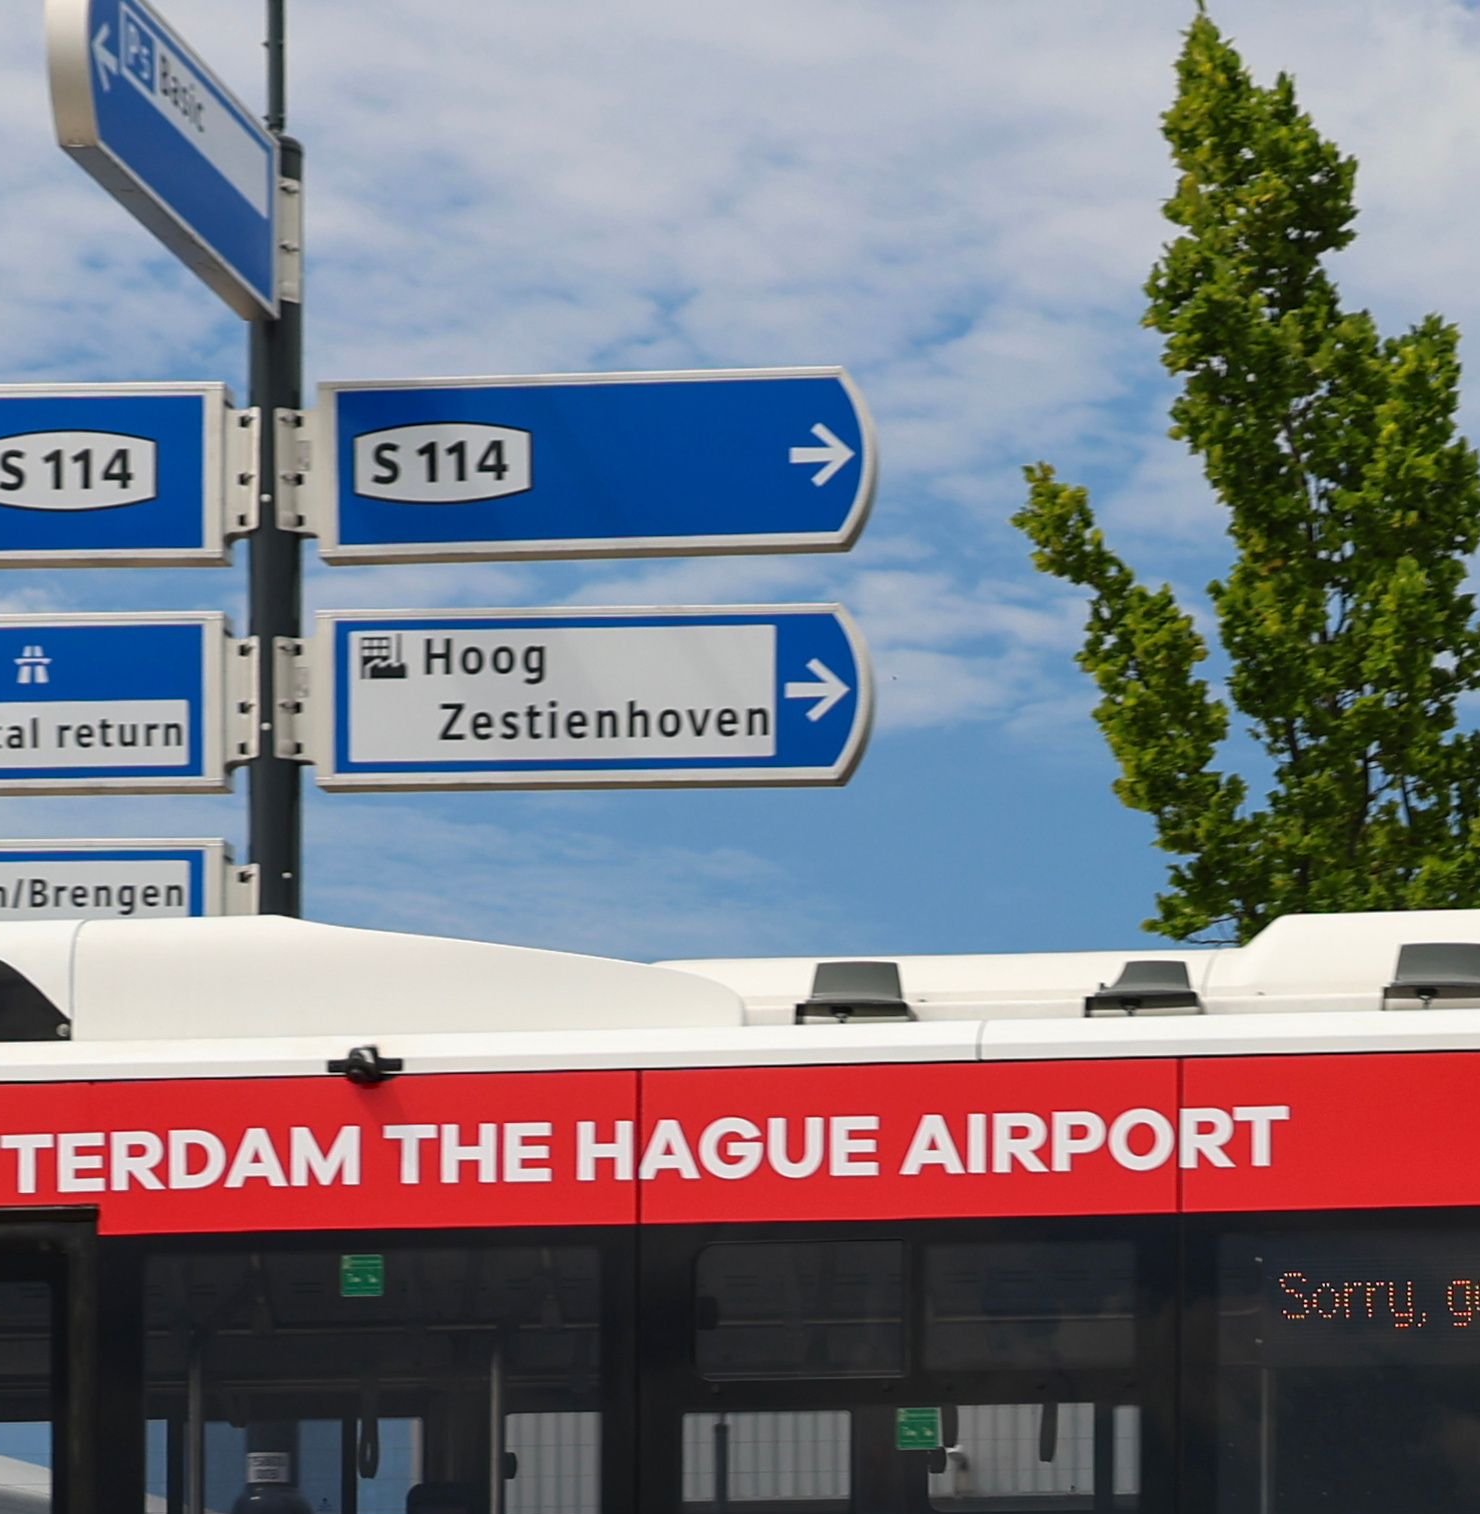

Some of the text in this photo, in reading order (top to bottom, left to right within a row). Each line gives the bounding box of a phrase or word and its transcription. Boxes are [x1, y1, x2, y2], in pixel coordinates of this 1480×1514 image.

[424, 637, 546, 685] Hoog
[57, 718, 182, 748] return
[438, 699, 770, 741] Zestienhoven
[383, 1121, 552, 1184] THE
[576, 1115, 879, 1181] HAGUE
[899, 1105, 1290, 1175] AIRPORT
[1278, 1271, 1428, 1328] Sorry,
